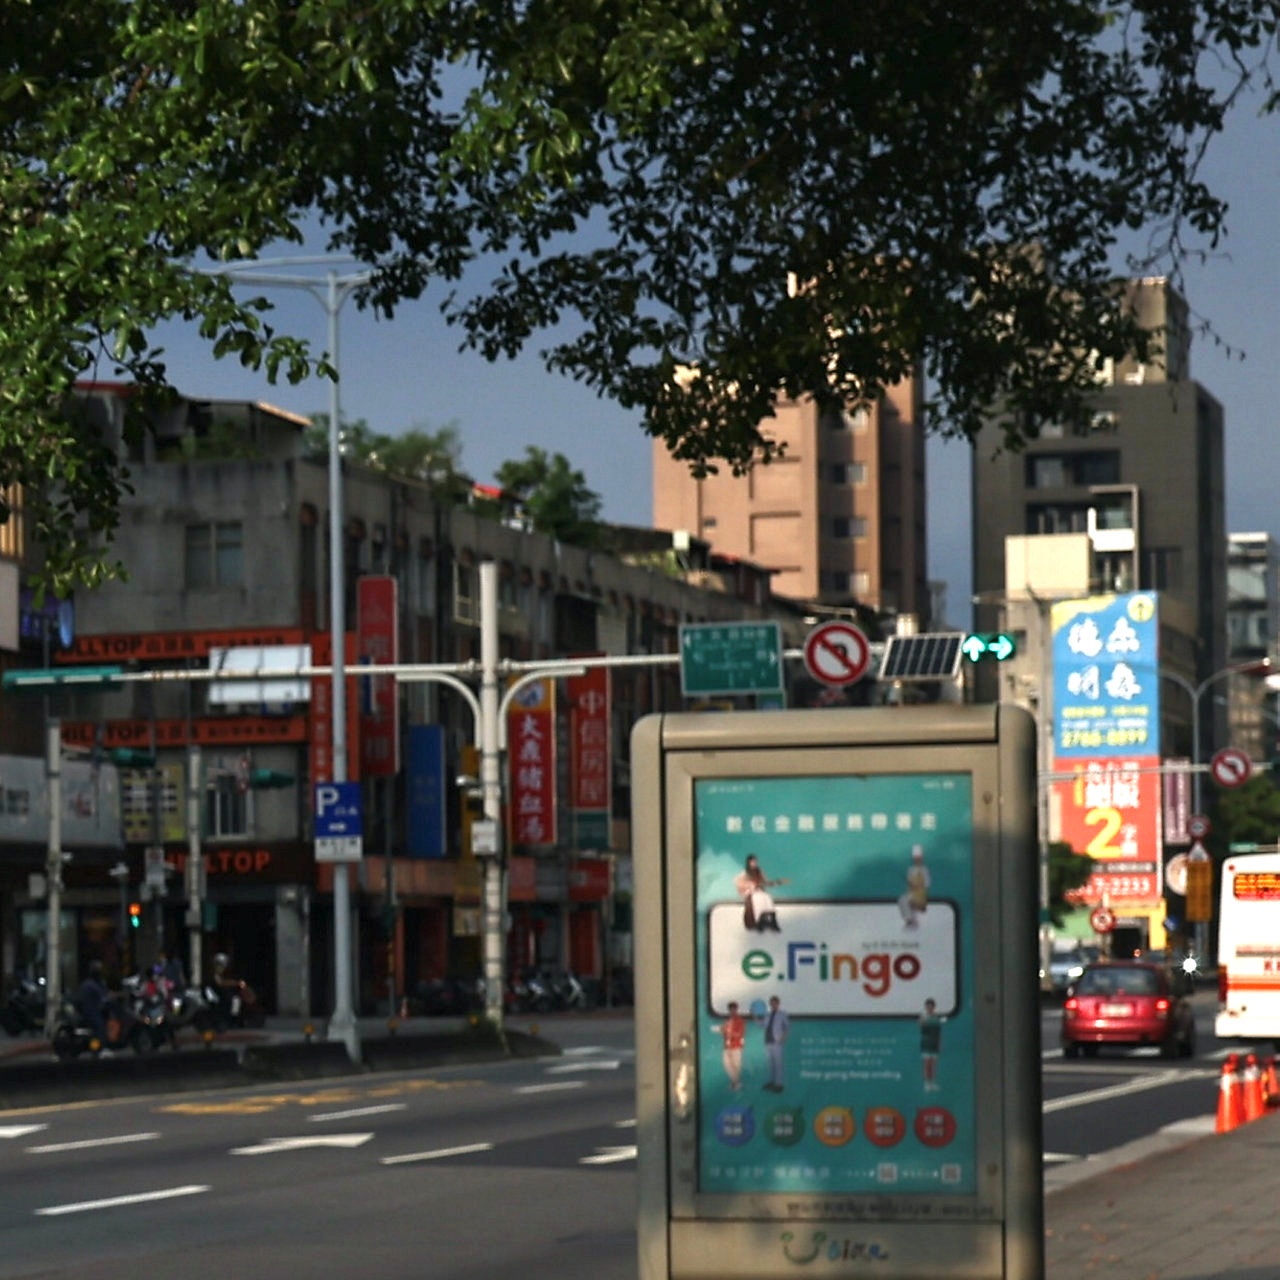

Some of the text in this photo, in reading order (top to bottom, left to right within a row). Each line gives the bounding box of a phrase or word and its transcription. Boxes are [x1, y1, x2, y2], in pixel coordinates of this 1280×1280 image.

[316, 787, 340, 818] P
[1084, 806, 1123, 859] 2
[741, 941, 922, 998] e.Fingo
